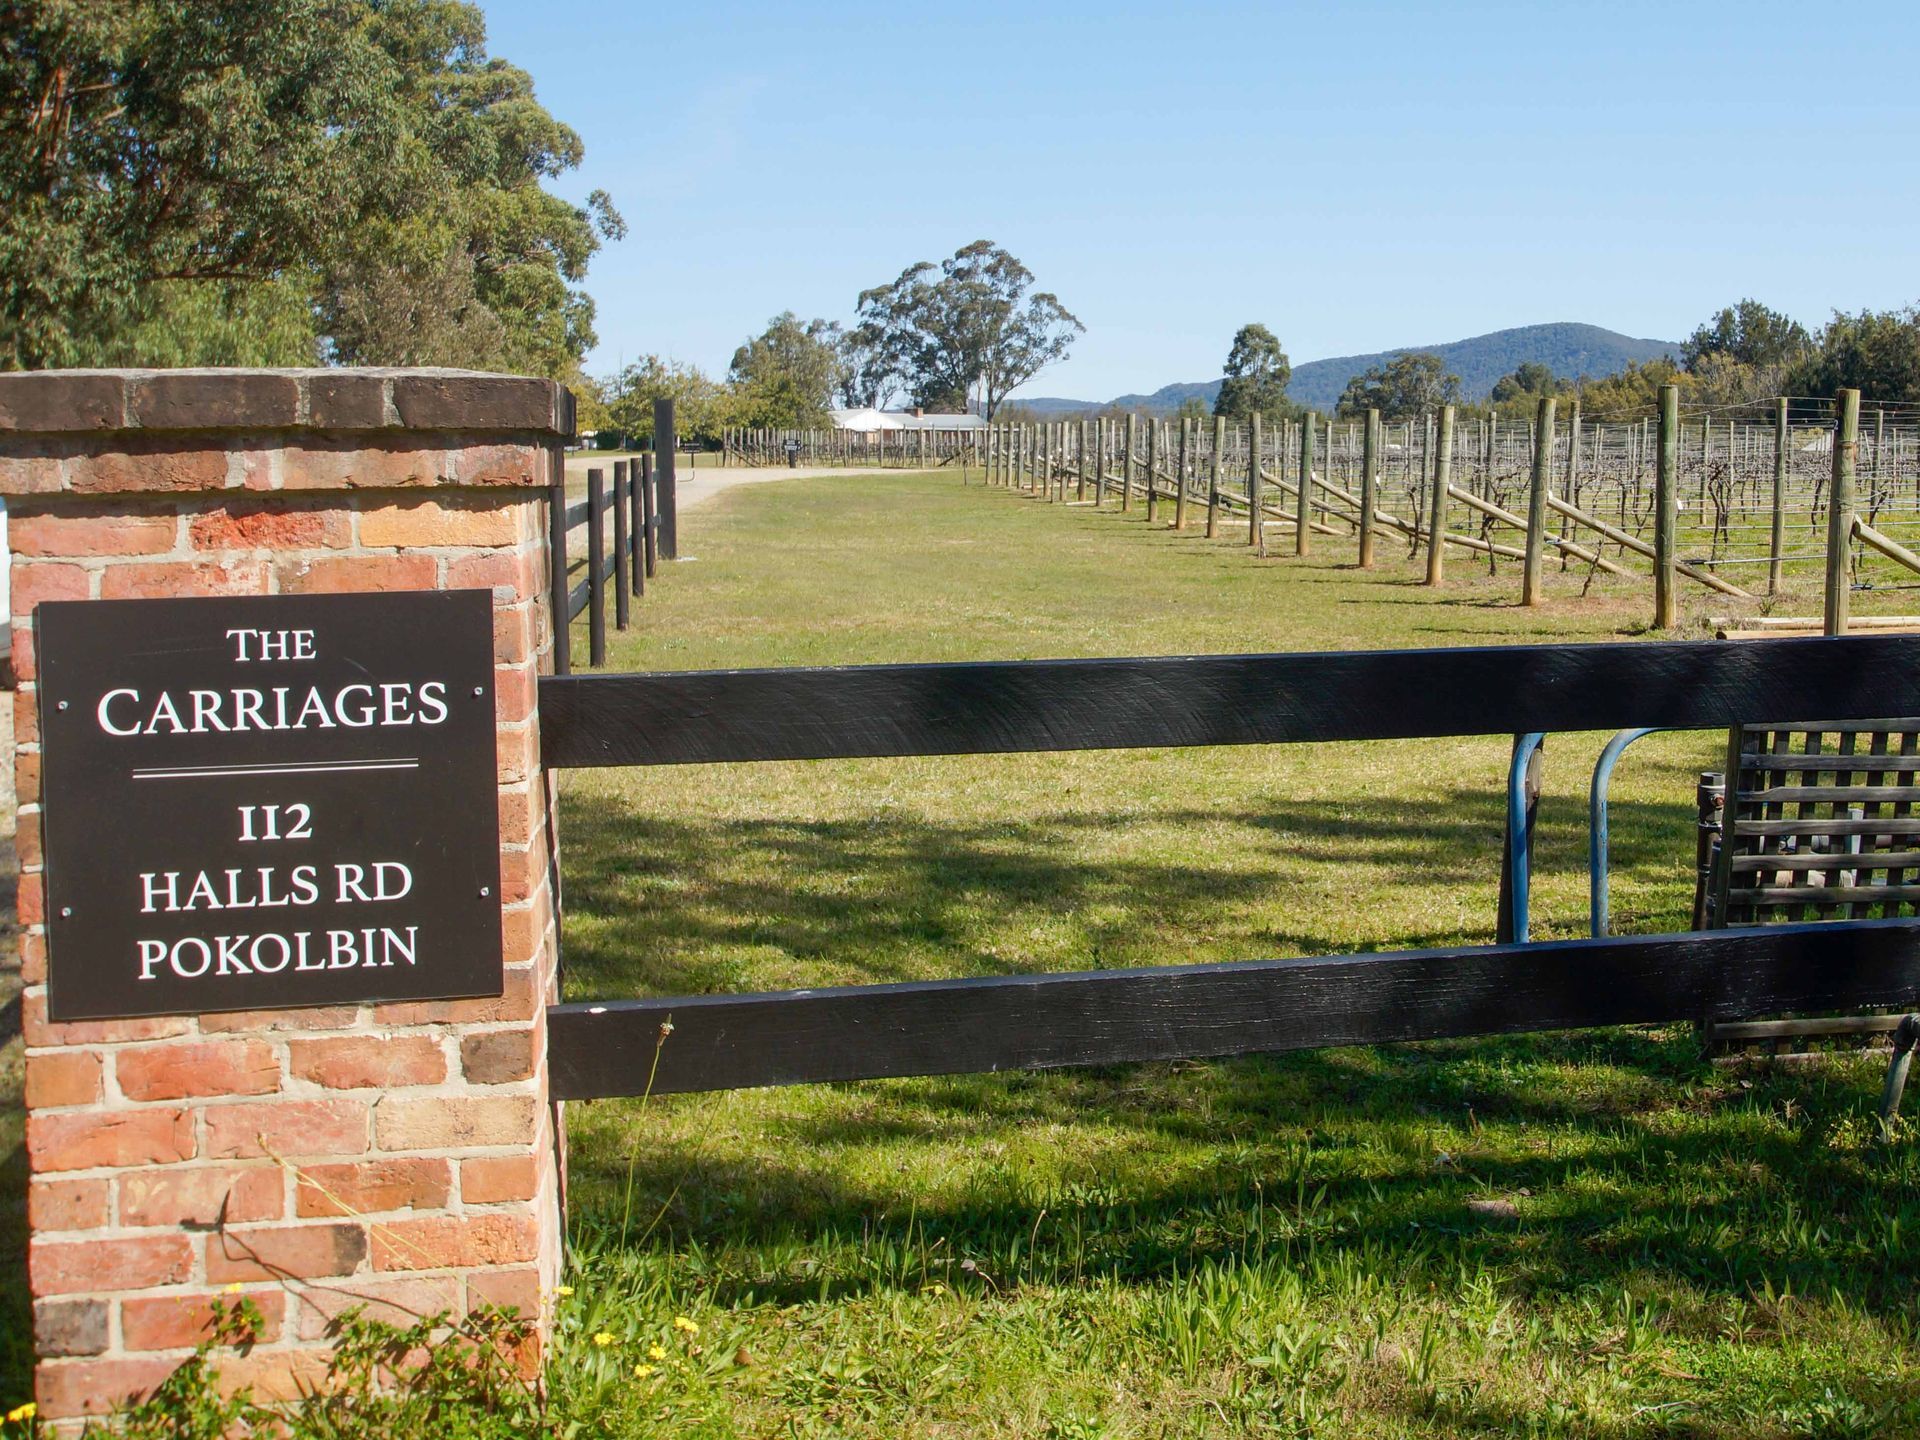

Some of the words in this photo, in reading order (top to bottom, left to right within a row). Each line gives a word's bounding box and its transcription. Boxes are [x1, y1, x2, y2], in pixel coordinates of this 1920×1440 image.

[226, 628, 317, 662] THE
[97, 682, 448, 736] CARRIAGES
[238, 803, 313, 842] 112
[139, 865, 319, 913] HALLS
[335, 861, 413, 903] RD
[137, 926, 419, 980] POKOLBIN
